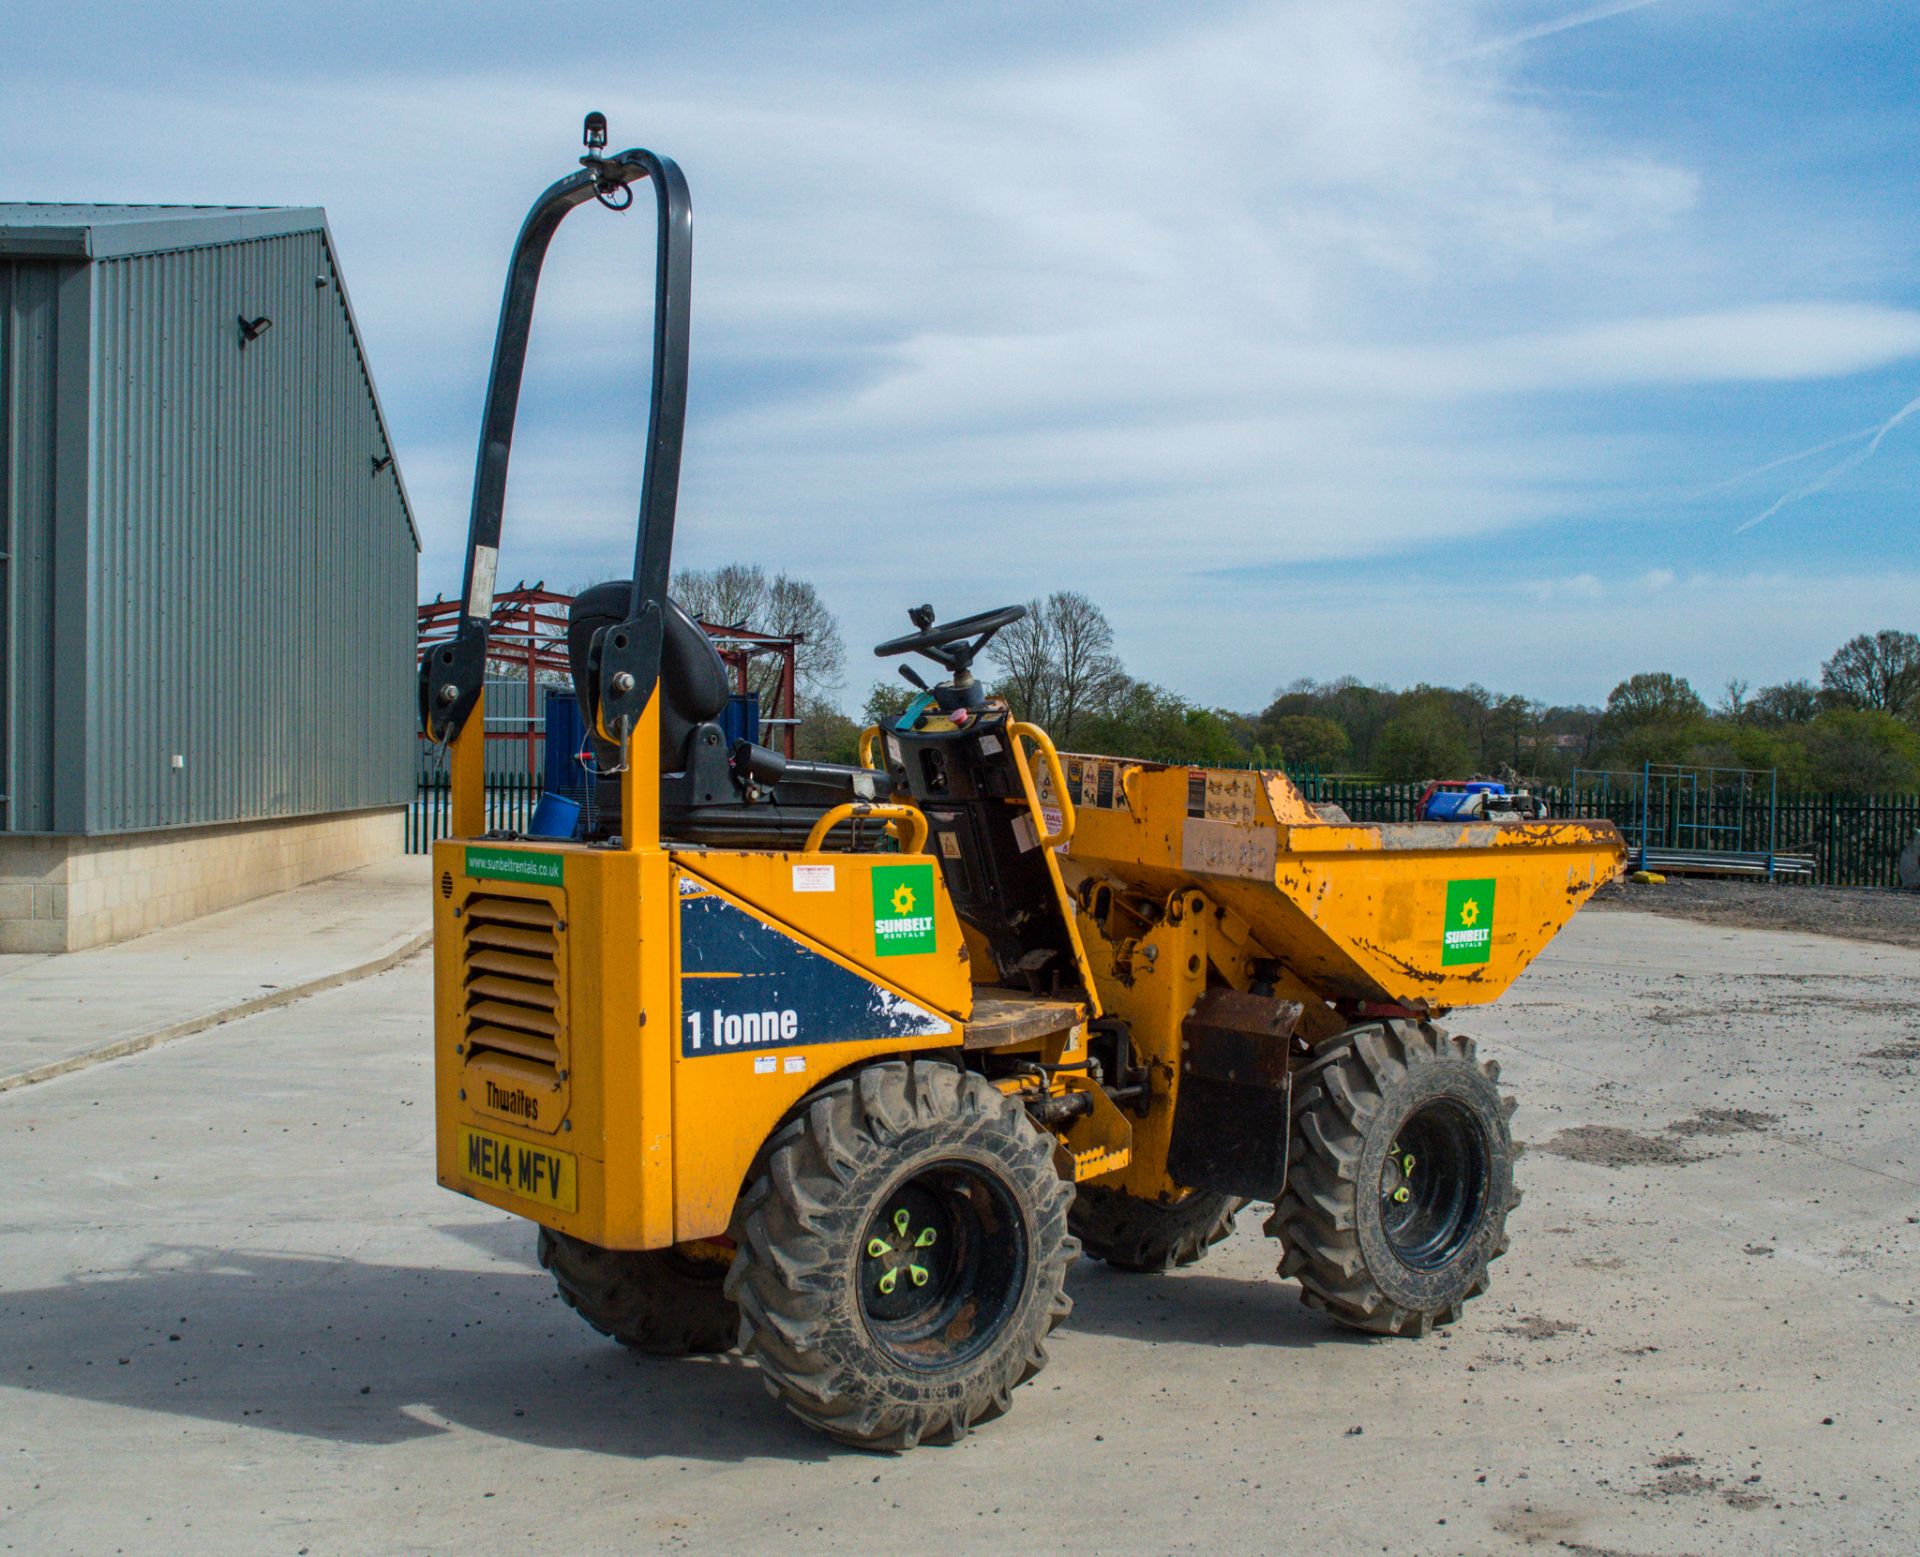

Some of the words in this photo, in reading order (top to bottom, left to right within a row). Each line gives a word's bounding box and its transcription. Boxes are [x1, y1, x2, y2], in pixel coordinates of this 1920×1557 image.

[469, 858, 559, 877] www.sunbeltrentals.co.uk
[875, 917, 932, 934] SUNBELT
[884, 931, 925, 939] RENTALS
[1445, 929, 1489, 944] SUNBELT
[688, 1011, 700, 1049] 1
[713, 1009, 798, 1046] tonne
[487, 1080, 538, 1120] Thwaites
[469, 1134, 512, 1185] ME14
[518, 1147, 560, 1200] MFV
